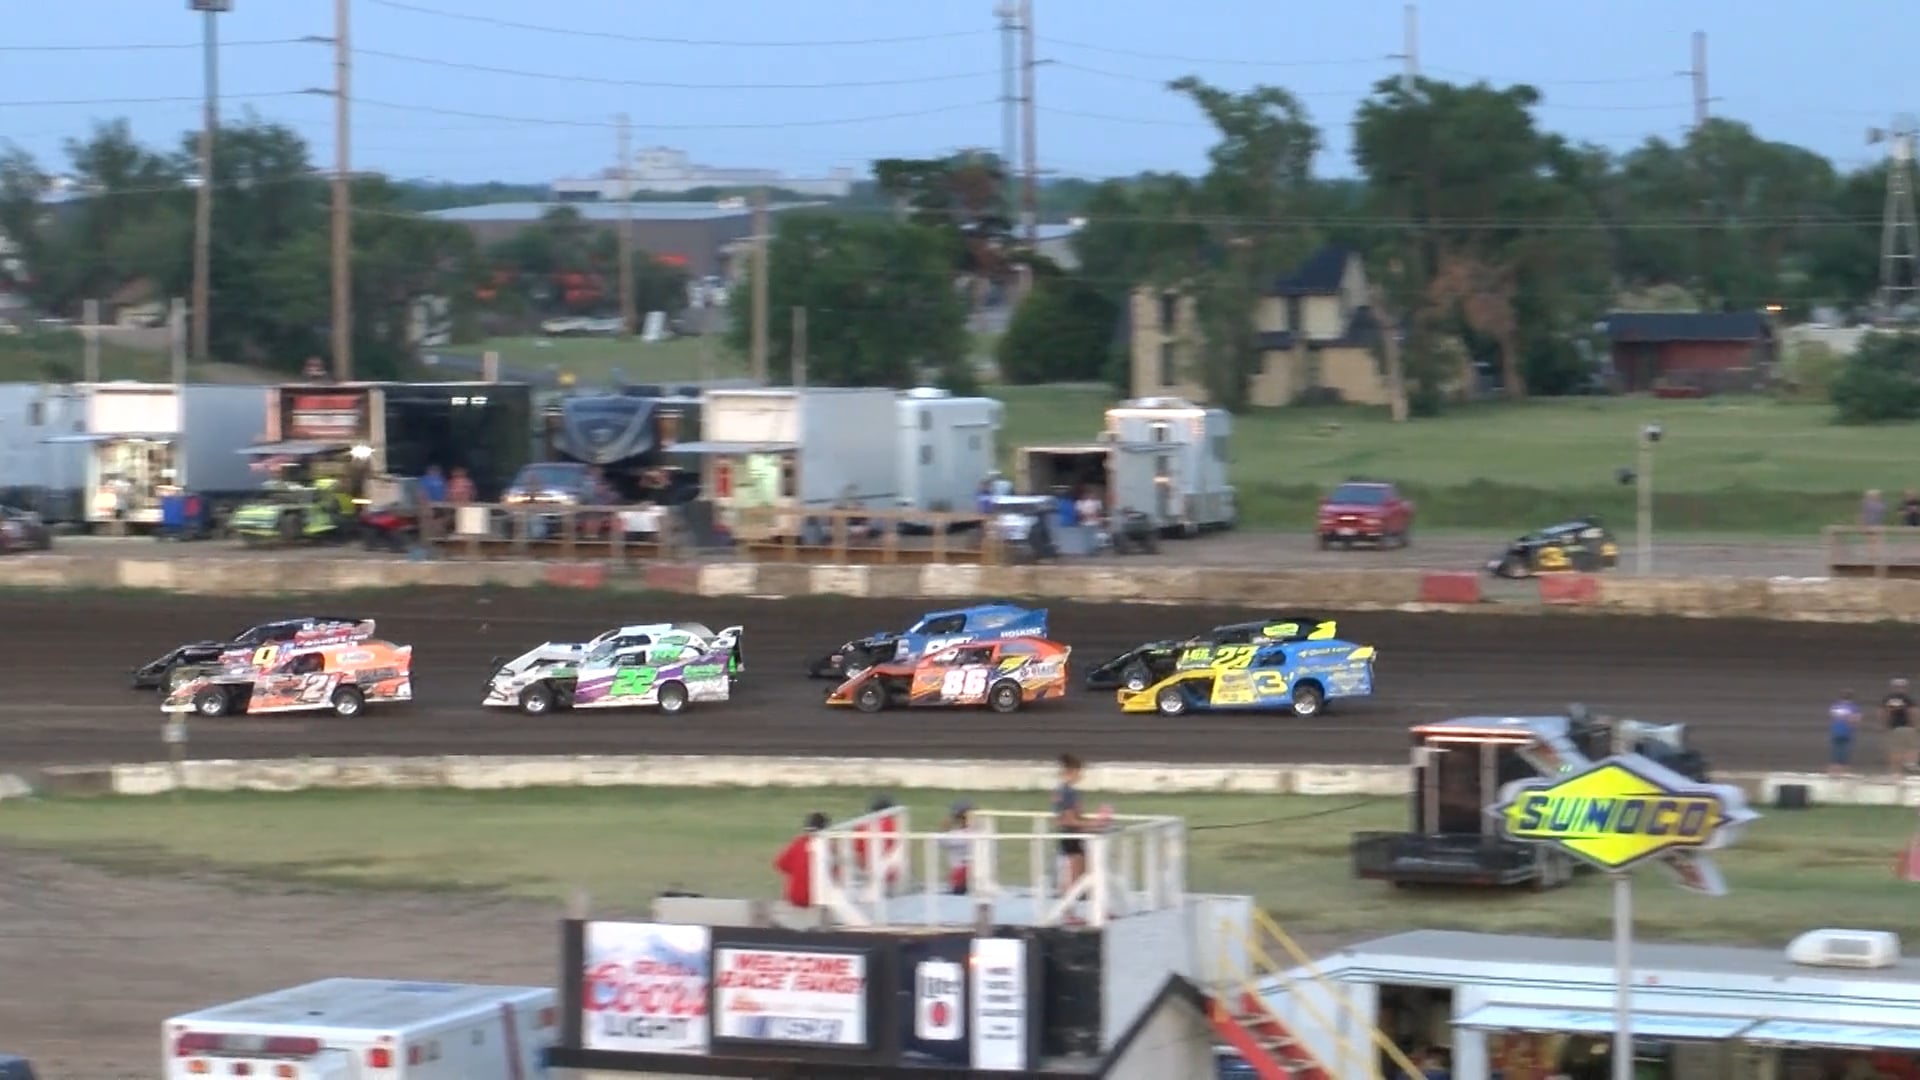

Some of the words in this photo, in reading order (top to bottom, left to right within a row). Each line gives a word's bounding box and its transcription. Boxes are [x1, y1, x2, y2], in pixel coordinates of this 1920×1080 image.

[609, 666, 659, 695] 22
[940, 668, 987, 695] 86
[1519, 796, 1709, 836] SUNOCO
[734, 953, 852, 975] WELCOME
[582, 961, 709, 1016] Coors
[715, 971, 787, 990] RACE
[602, 1014, 689, 1041] LIGHT
